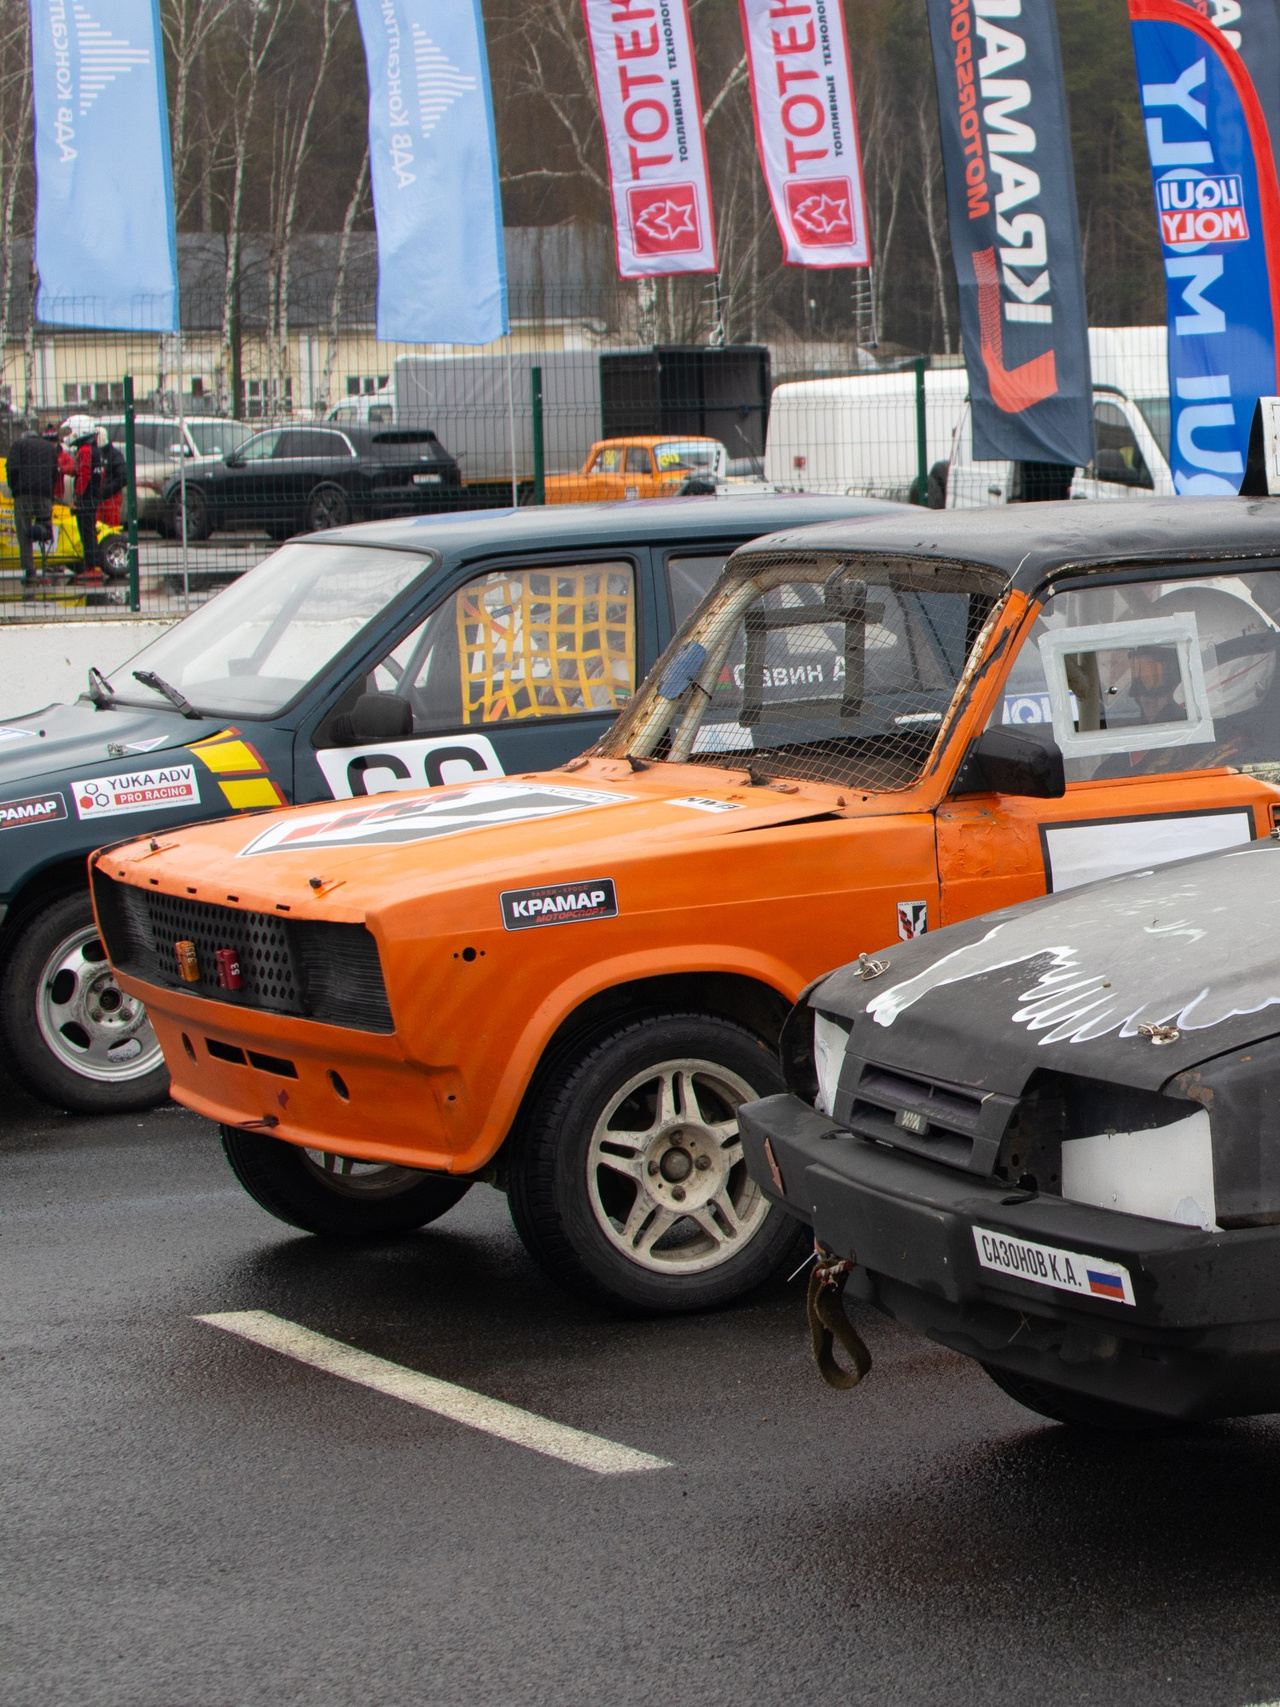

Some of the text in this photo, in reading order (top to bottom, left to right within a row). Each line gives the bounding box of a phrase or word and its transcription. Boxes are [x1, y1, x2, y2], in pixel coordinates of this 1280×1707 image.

[670, 79, 689, 163] ТОПЛИВНЫЕ
[826, 75, 844, 157] ТОПЛИВНЫЕ
[106, 768, 191, 791] YUKA ADV
[120, 786, 188, 804] PRO RACING
[512, 890, 606, 918] КРАМАР
[535, 906, 606, 923] МОТОРСПОРТ
[231, 962, 241, 976] 53
[981, 1234, 1083, 1287] САЗОНОВ К.А.
